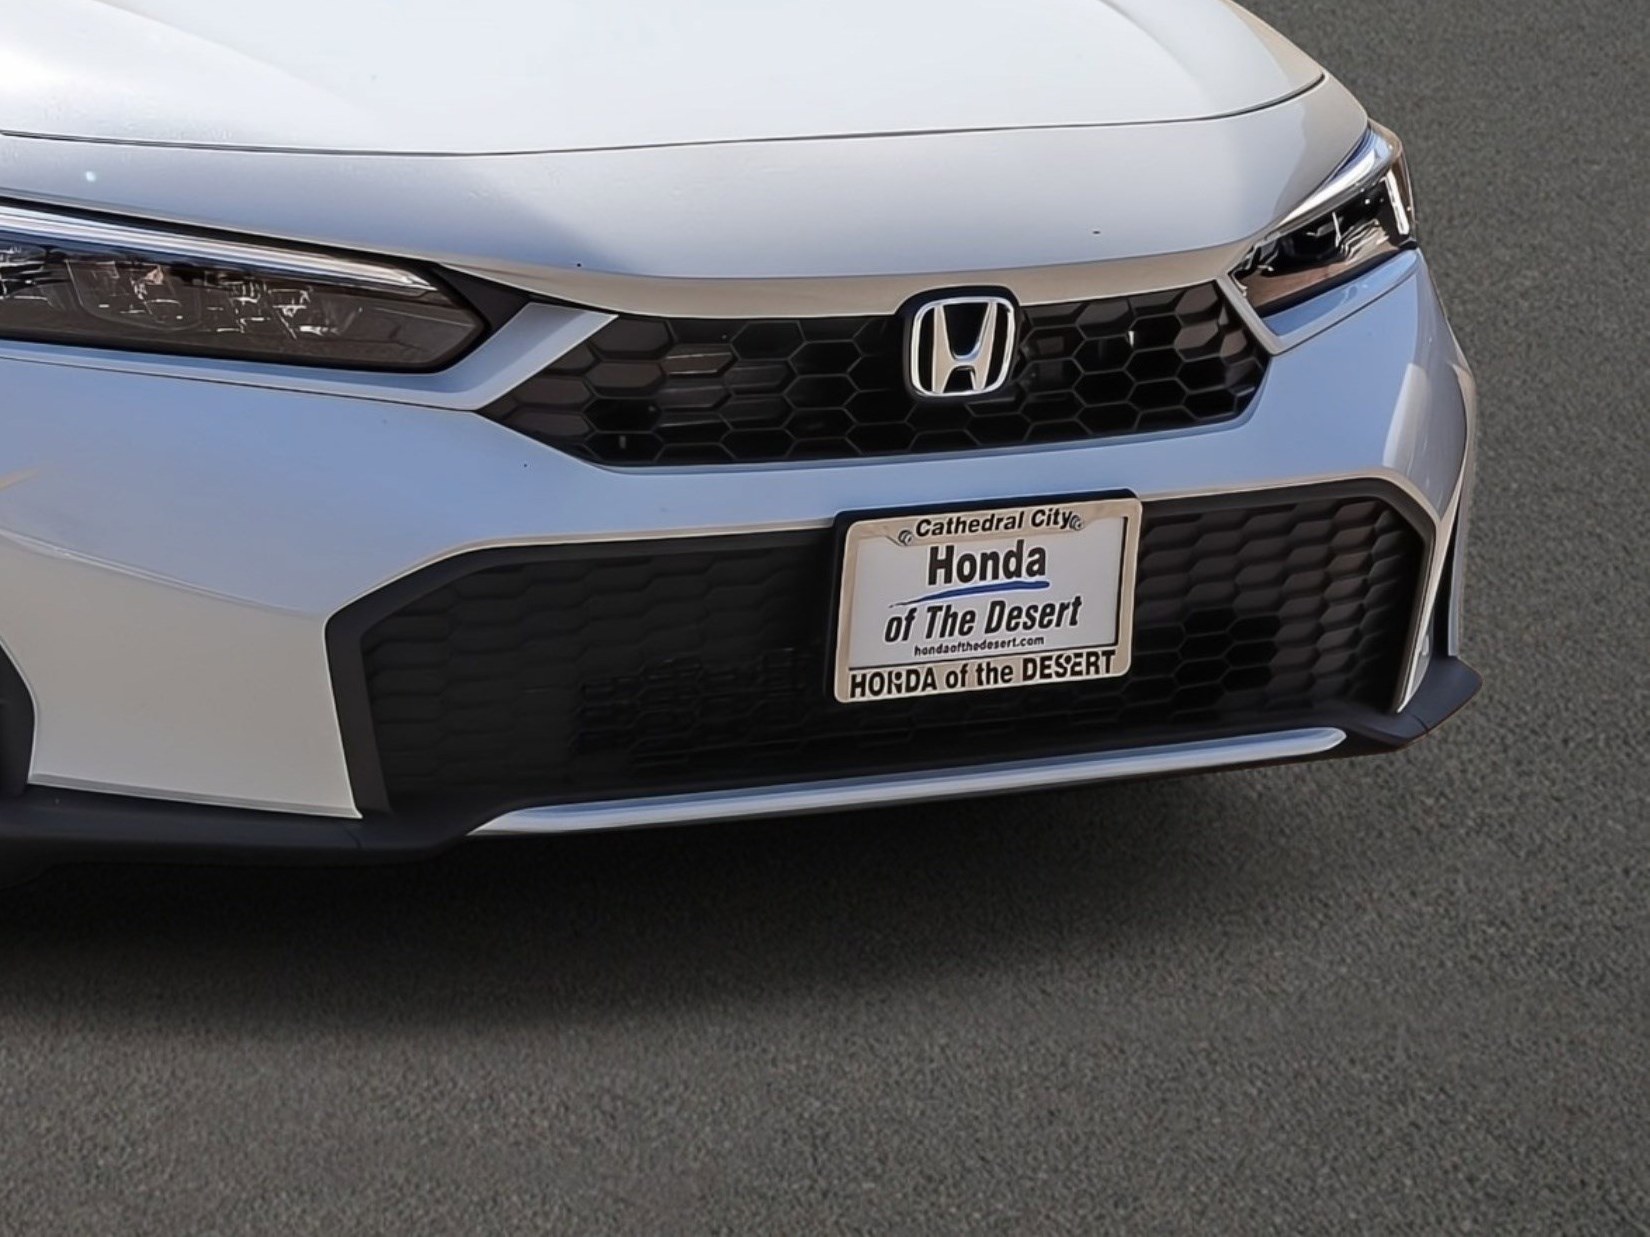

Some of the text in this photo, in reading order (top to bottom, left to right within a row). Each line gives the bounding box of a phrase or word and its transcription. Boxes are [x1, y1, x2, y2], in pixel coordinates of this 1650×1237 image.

[915, 508, 1072, 538] Cathedral City
[928, 539, 1047, 586] Honda
[884, 595, 1082, 643] of The Desert
[914, 636, 1045, 657] hondaofthedesert.com
[850, 649, 1116, 699] HONDA of the DESERT
